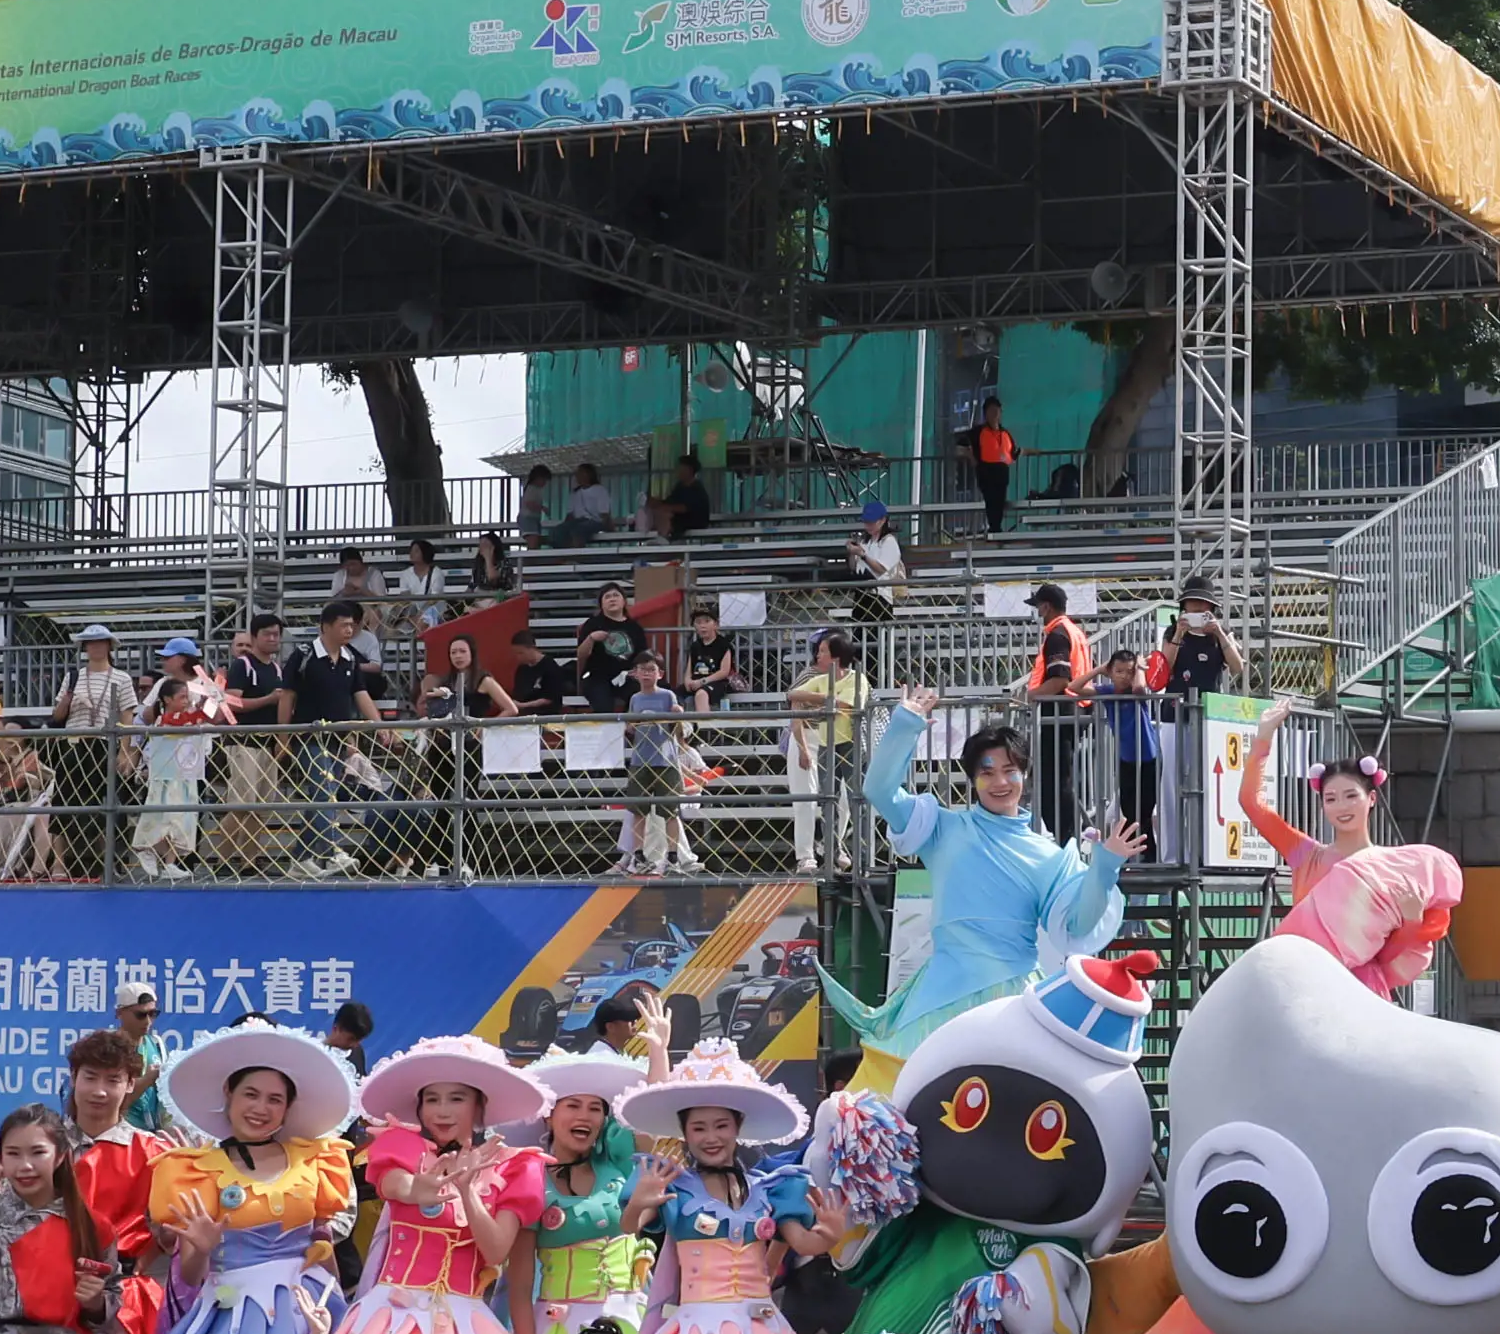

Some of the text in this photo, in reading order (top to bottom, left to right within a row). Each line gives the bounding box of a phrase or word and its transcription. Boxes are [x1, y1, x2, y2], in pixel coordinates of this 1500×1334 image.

[28, 50, 146, 77] Internacionais
[150, 46, 173, 64] de
[178, 32, 305, 60] Barcos-Dragão
[309, 29, 333, 47] de
[339, 26, 398, 46] Macau
[666, 24, 780, 50] SJM Resorts, S.A.
[78, 76, 127, 98] Dragon
[130, 72, 161, 88] Boat
[163, 68, 202, 84] Races
[1228, 736, 1239, 767] 3
[1228, 825, 1238, 856] 2
[977, 1228, 1008, 1244] Mak
